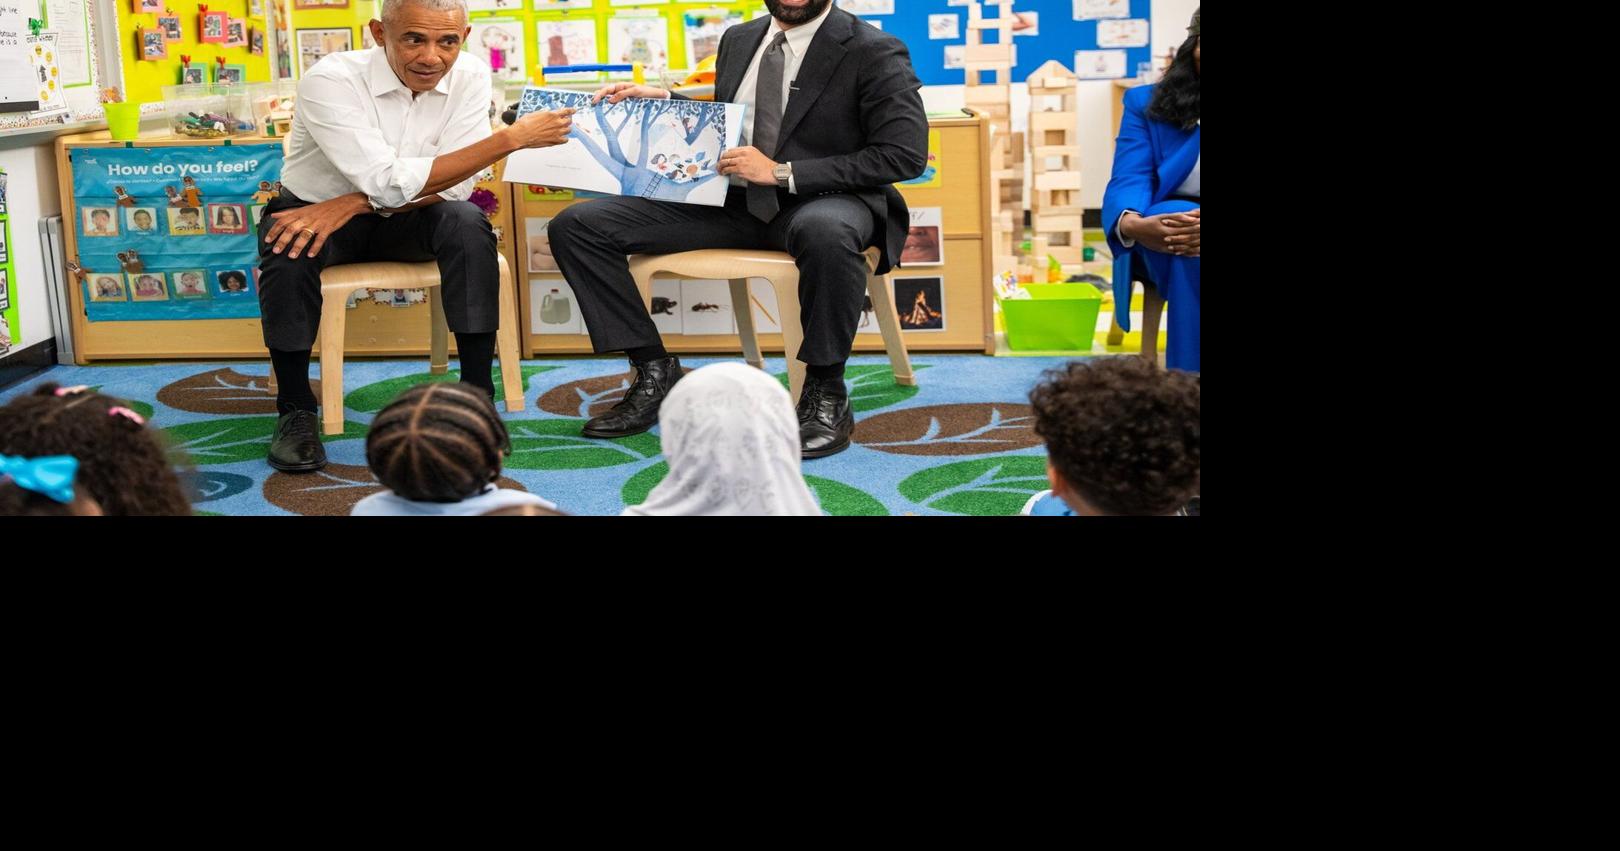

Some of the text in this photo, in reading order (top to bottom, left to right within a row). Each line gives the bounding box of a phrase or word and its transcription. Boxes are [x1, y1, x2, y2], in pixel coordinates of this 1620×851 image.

[108, 160, 259, 177] How do you feel?
